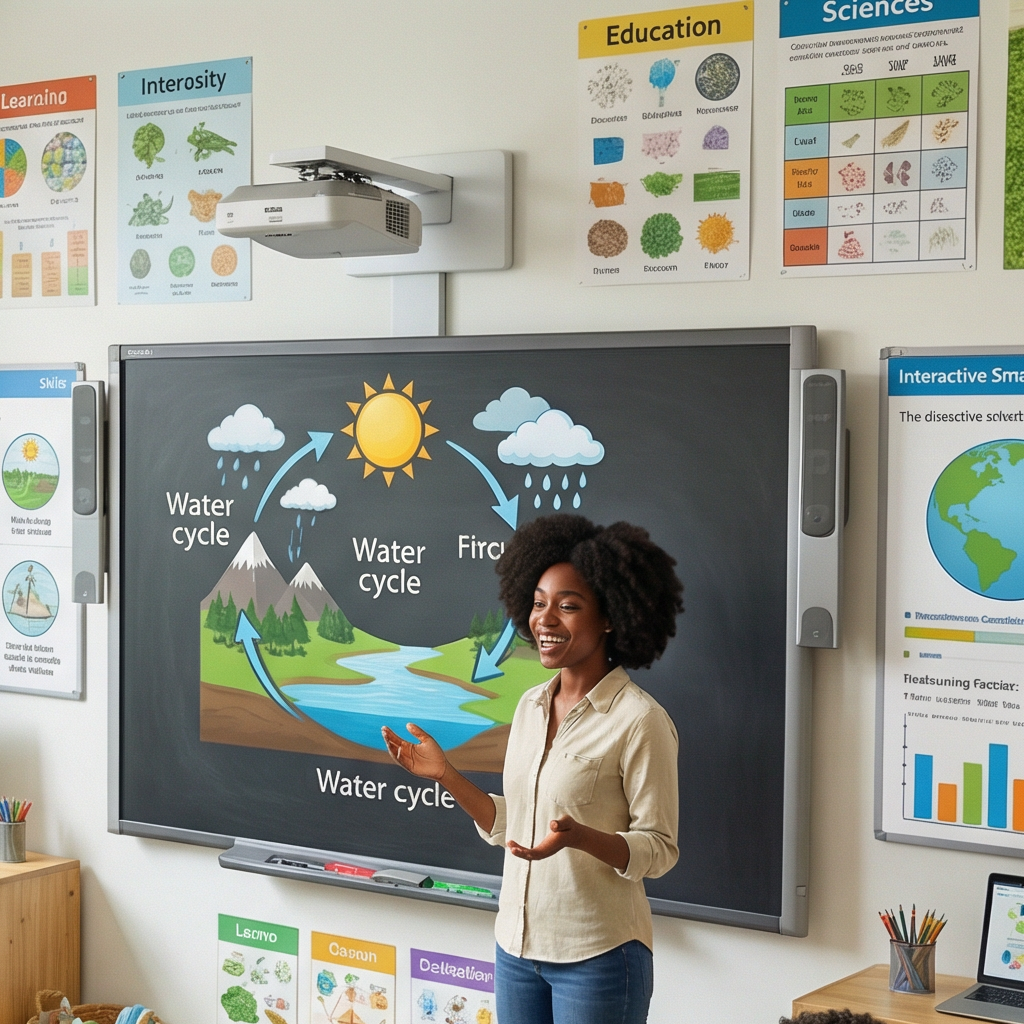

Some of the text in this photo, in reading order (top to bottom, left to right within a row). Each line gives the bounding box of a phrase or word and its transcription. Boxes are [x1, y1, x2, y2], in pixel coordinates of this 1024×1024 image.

[822, 0, 934, 23] Sciences
[607, 16, 721, 46] Education
[141, 69, 227, 95] Interosity
[899, 367, 987, 384] Interactive
[899, 411, 922, 422] The
[166, 491, 235, 517] Water
[172, 520, 230, 552] cycle
[352, 537, 426, 564] Water
[358, 568, 421, 599] cycle
[316, 767, 455, 812] Water cycle
